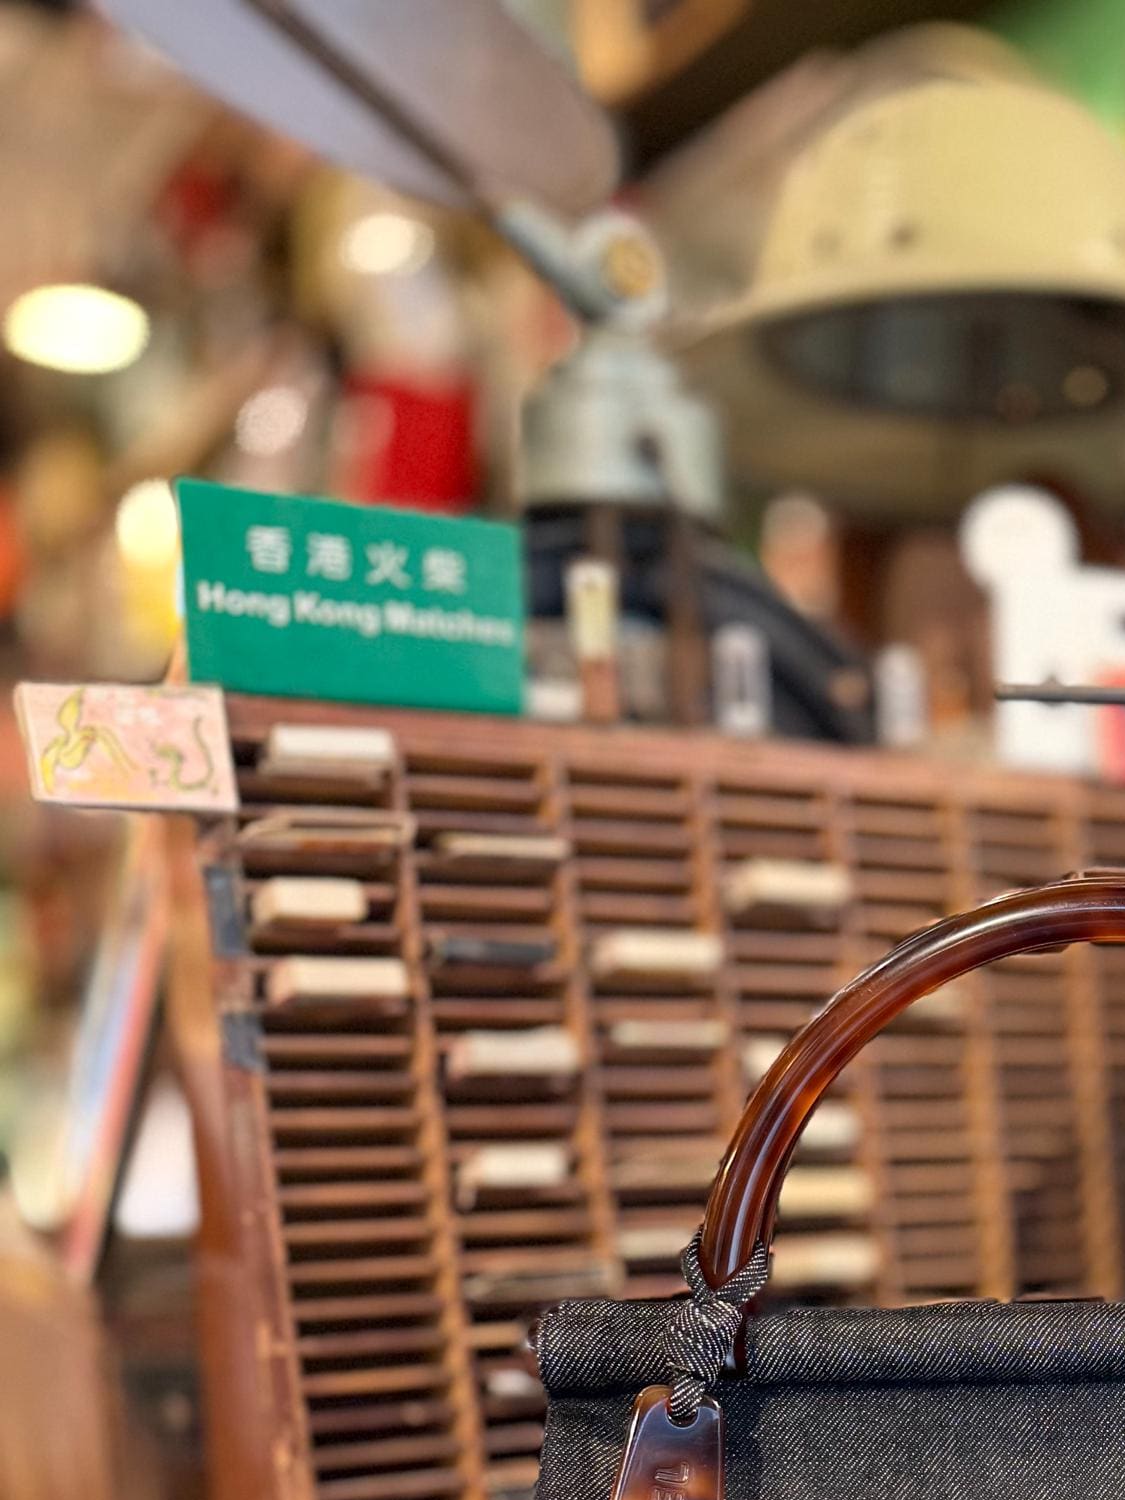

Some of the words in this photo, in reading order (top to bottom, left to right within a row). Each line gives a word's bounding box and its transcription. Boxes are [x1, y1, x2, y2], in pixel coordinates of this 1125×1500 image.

[246, 523, 466, 595] 香港火柴
[196, 578, 290, 628] Hong
[294, 589, 382, 638] Kong
